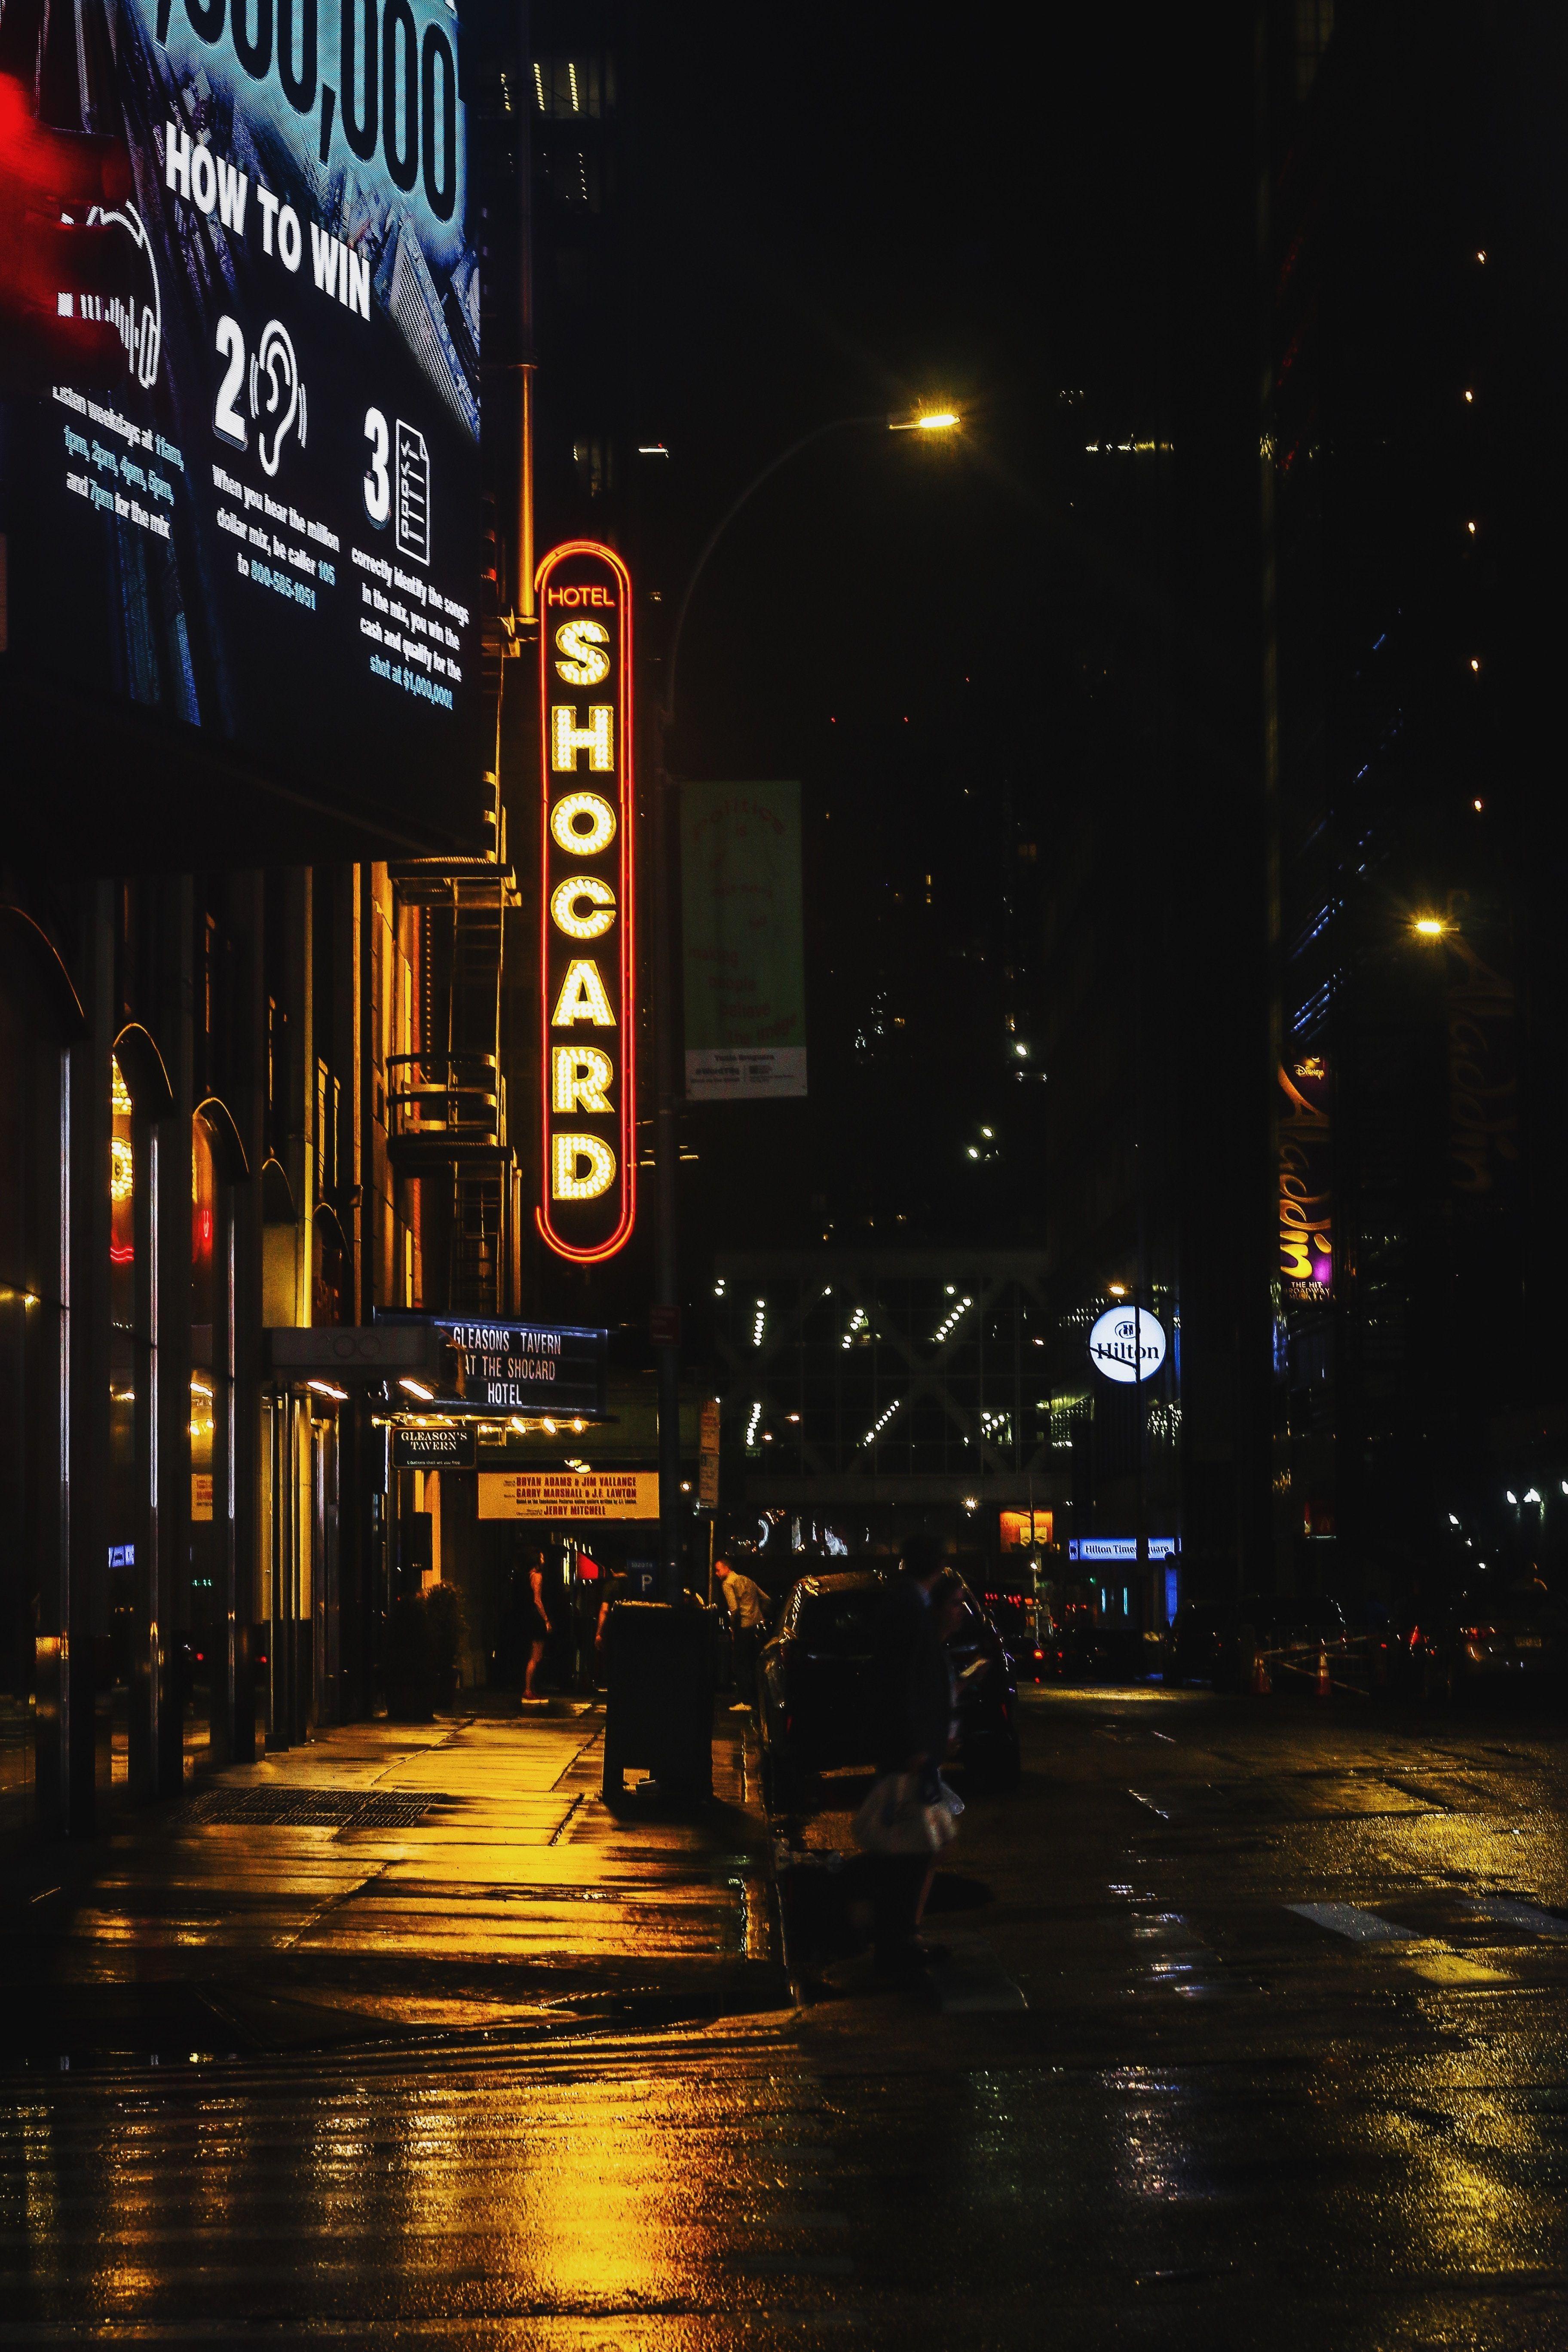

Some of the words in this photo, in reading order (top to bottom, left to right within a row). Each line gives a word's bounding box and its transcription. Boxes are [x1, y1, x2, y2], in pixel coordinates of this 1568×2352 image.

[166, 121, 248, 236] HOW
[257, 184, 302, 273] TO
[310, 221, 371, 322] WIN
[211, 314, 248, 452] 2
[87, 400, 141, 447] weekdays
[141, 429, 153, 451] at
[155, 434, 184, 472] 11am,
[64, 426, 90, 462] 1pm,
[92, 440, 118, 477] 2pm,
[120, 456, 147, 492] 4pm,
[148, 470, 174, 506] 5pm,
[360, 406, 390, 524] 3
[66, 472, 89, 498] and
[89, 478, 114, 511] 7pm
[115, 493, 130, 518] for
[131, 500, 149, 528] the
[150, 514, 170, 539] mix
[212, 465, 242, 500] When
[243, 486, 263, 511] you
[264, 493, 288, 524] hear
[288, 507, 306, 534] the
[307, 521, 340, 553] million
[217, 508, 248, 539] dollar
[249, 527, 271, 557] mix,
[273, 536, 287, 560] be
[288, 548, 316, 576] caller
[318, 560, 336, 586] 105
[237, 553, 250, 577] to
[351, 548, 392, 588] correctly
[393, 567, 427, 607] identify
[428, 585, 443, 610] the
[444, 598, 469, 628] songs
[548, 586, 615, 607] HOTEL
[362, 583, 372, 606] in
[373, 588, 389, 614] the
[390, 601, 410, 628] mix,
[410, 612, 427, 634] you
[428, 621, 444, 644] win
[445, 627, 460, 652] the
[360, 618, 383, 643] cash
[384, 630, 402, 652] and
[402, 639, 433, 673] qualify
[433, 651, 446, 674] for
[447, 658, 462, 683] the
[370, 655, 391, 680] shot
[392, 666, 403, 686] at
[551, 619, 617, 1200] SHOCARD
[453, 1326, 509, 1351] GLEASONS
[521, 1332, 560, 1354] TAVERN
[1097, 1342, 1159, 1359] Hilton
[482, 1356, 502, 1377] THE
[508, 1357, 555, 1381] SHOCARD
[488, 1382, 522, 1405] HOTEL
[401, 1432, 468, 1441] GLEASON'S
[410, 1442, 456, 1450] TAVERN
[516, 1477, 541, 1486] BRYAN
[545, 1477, 572, 1486] ADAMS
[581, 1477, 596, 1486] JIM
[599, 1477, 636, 1486] VALLANCE
[516, 1488, 541, 1498] GARRY
[544, 1488, 582, 1498] MARSHALL
[606, 1488, 636, 1498] LAWTON
[544, 1505, 567, 1515] JERRY
[570, 1505, 606, 1515] MITCHELL
[1085, 1545, 1107, 1555] Hilton
[1148, 1546, 1169, 1554] uare
